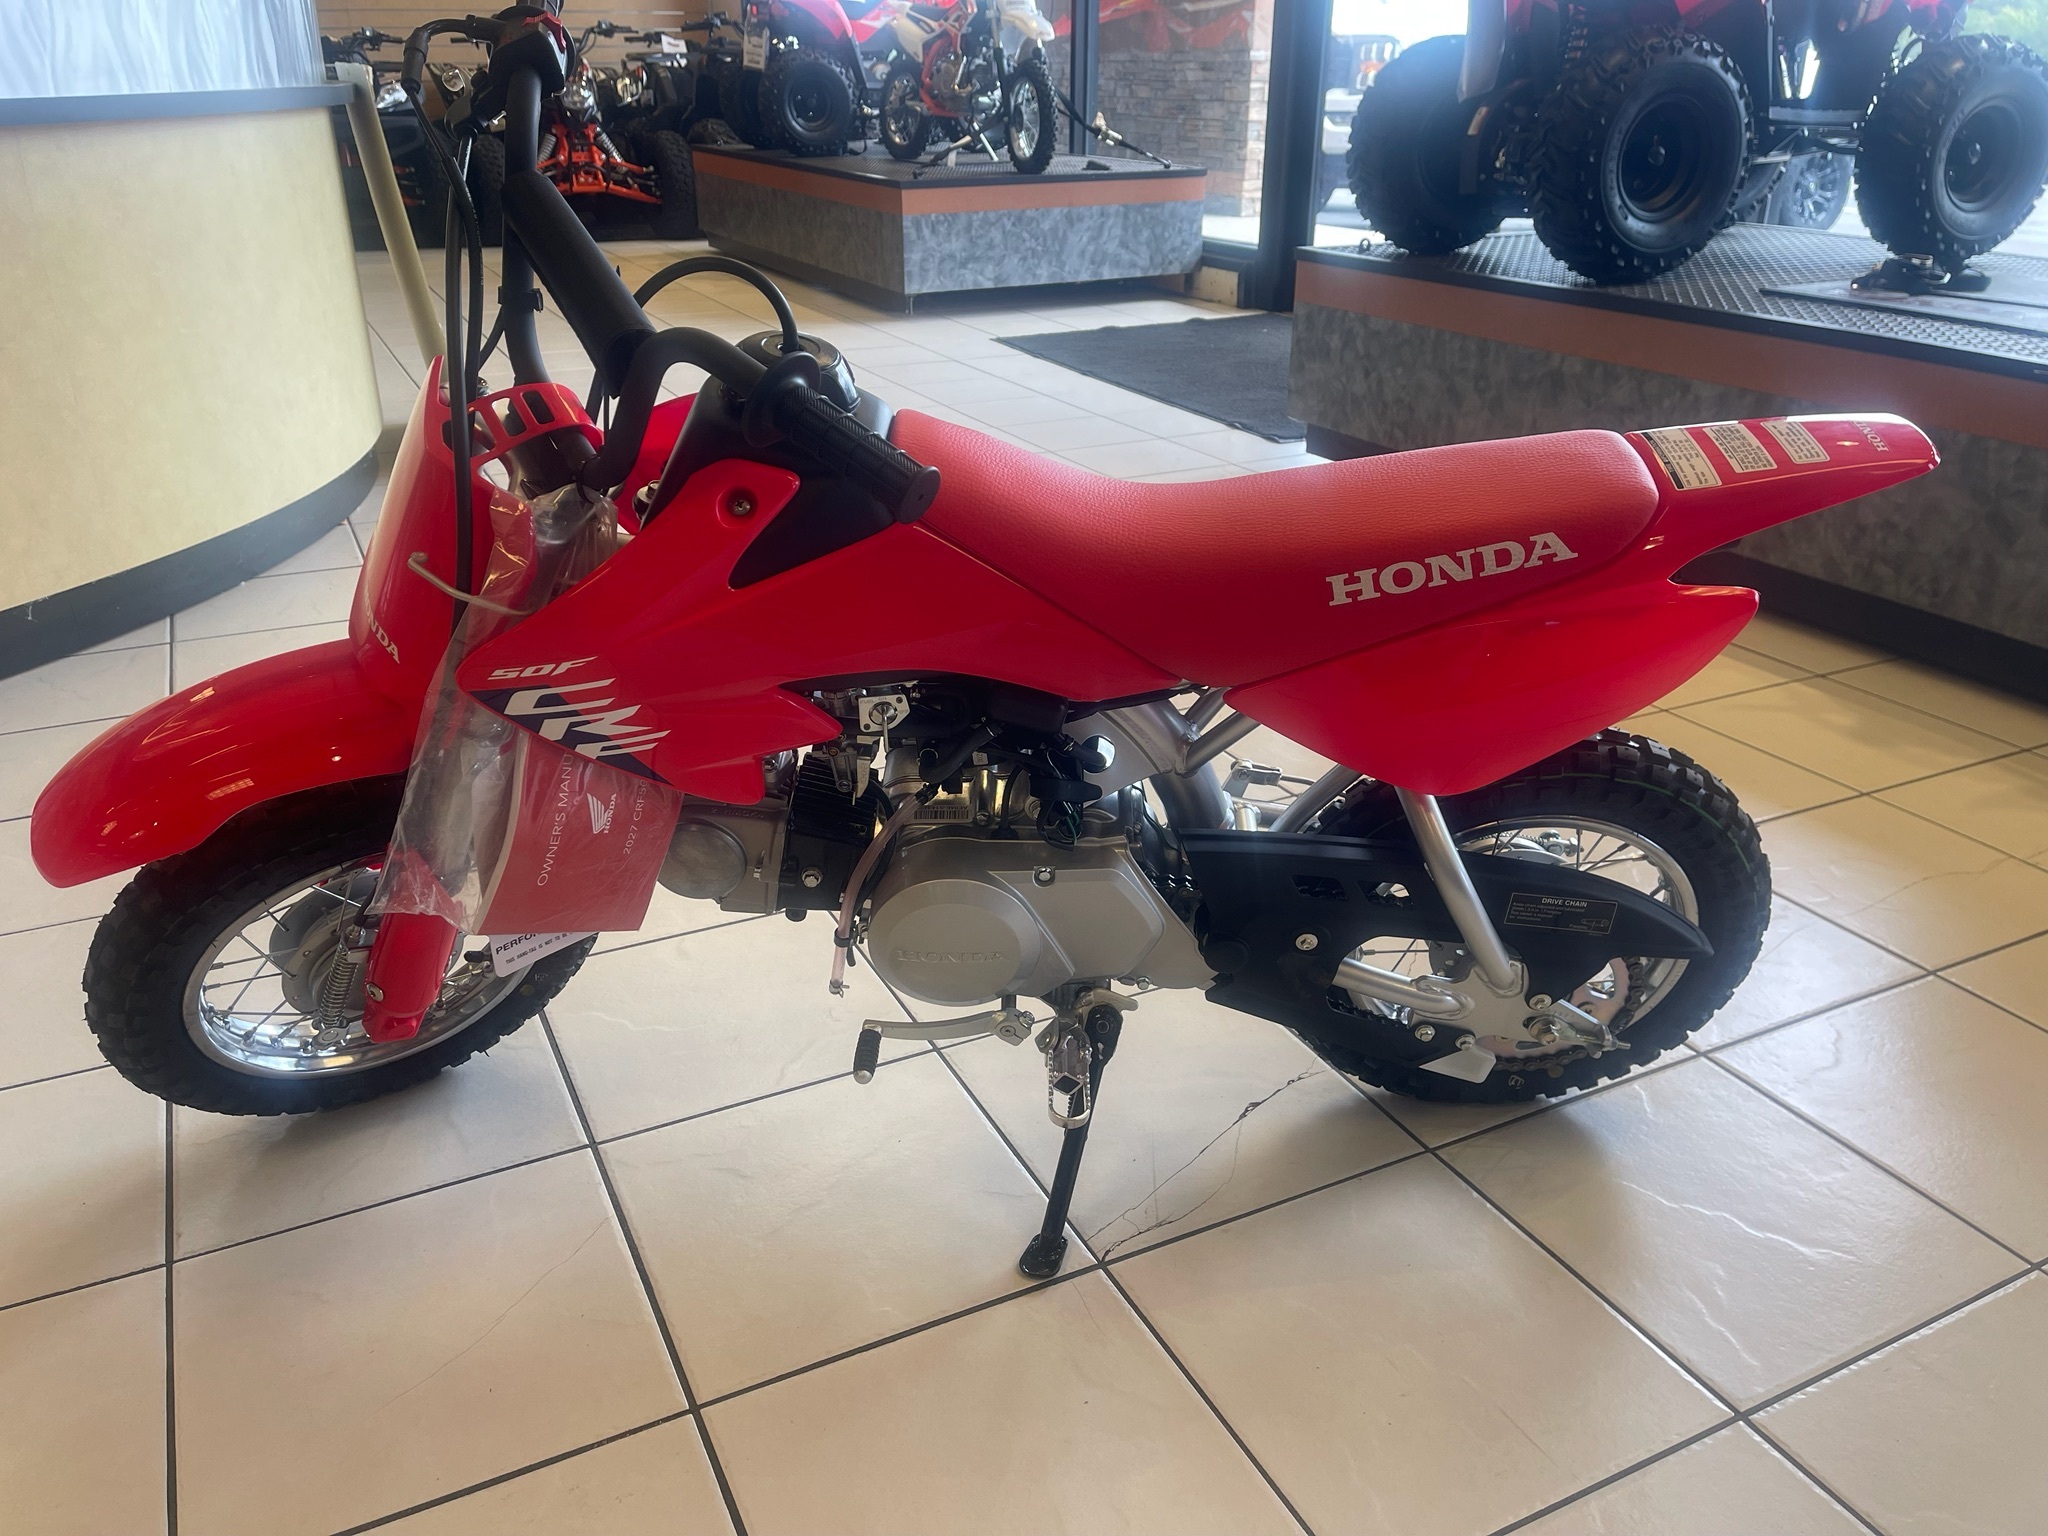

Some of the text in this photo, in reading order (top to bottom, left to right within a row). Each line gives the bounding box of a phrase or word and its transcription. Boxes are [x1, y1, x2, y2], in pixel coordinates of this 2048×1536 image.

[1326, 531, 1578, 606] HONDA
[487, 656, 598, 680] 50F
[537, 753, 574, 886] OWNER'S MANU
[603, 793, 617, 834] HONDA
[623, 780, 648, 855] 2027 CRF50
[1541, 897, 1588, 908] DRIVE CHAIN
[495, 933, 541, 955] PERFO
[896, 949, 1009, 964] HONDA
